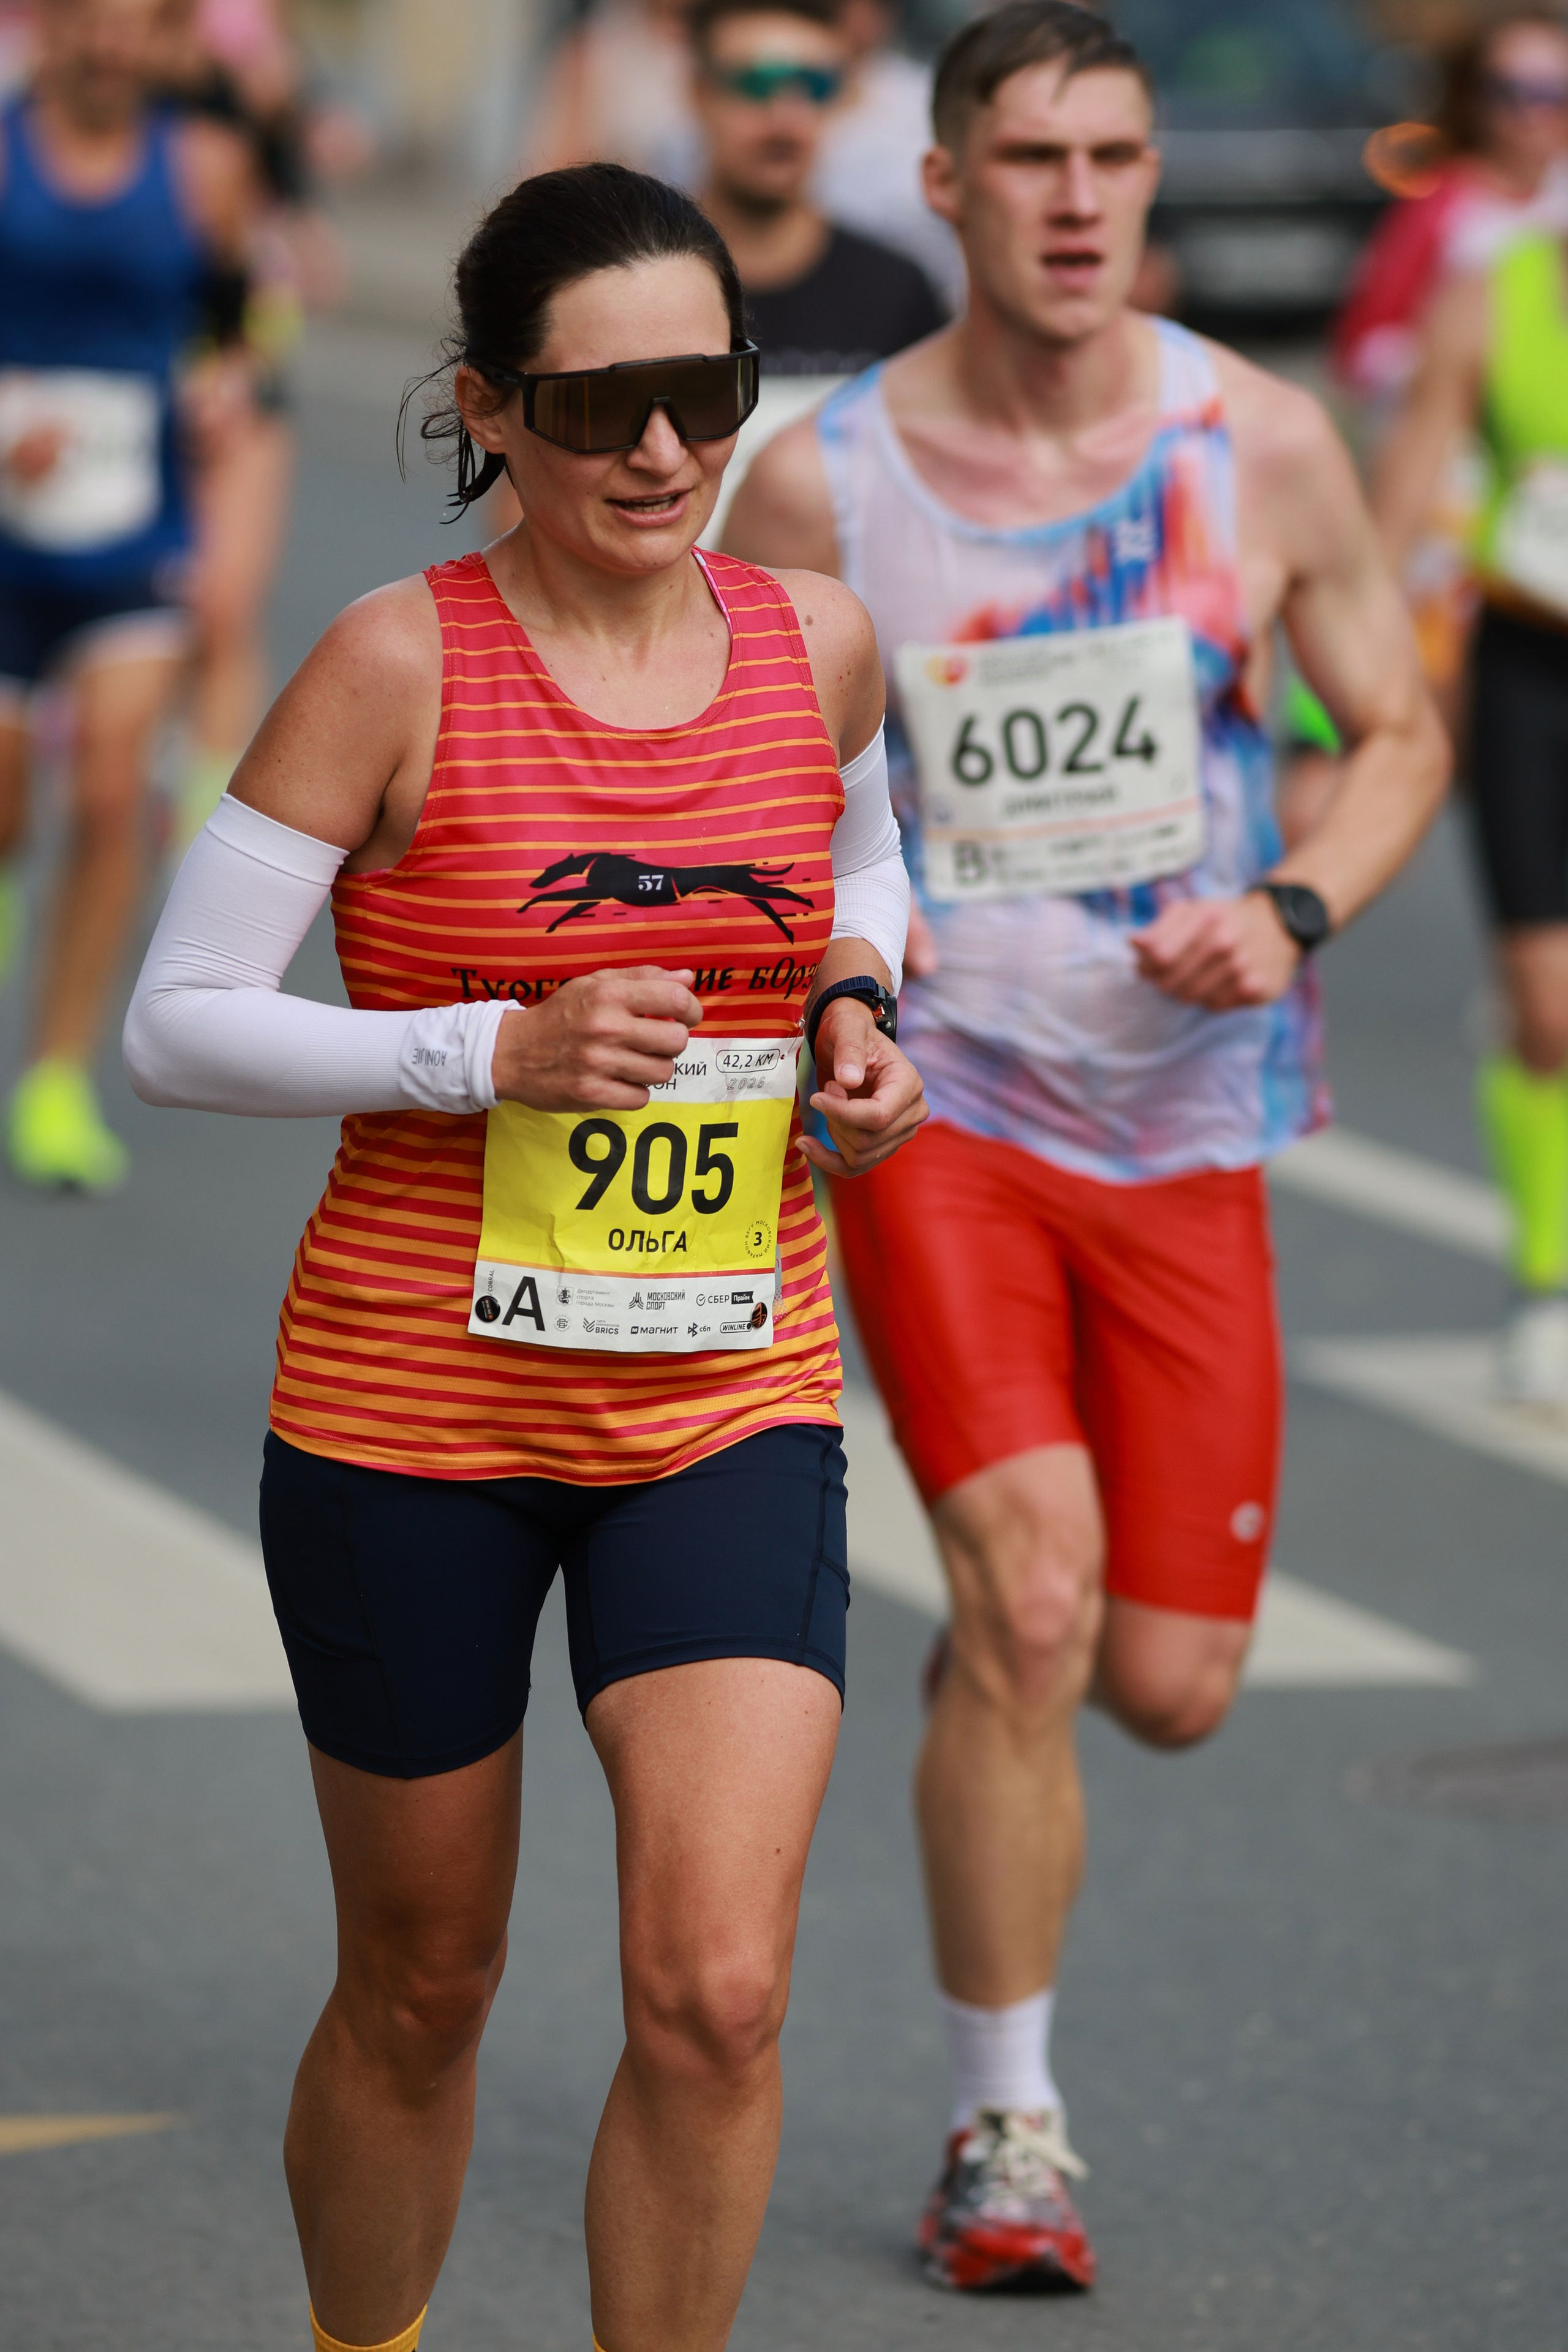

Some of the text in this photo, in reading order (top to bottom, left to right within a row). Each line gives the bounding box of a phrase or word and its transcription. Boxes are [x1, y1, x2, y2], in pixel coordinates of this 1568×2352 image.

[951, 694, 1156, 786] 6024
[638, 875, 664, 891] 57
[723, 1054, 753, 1069] 42,2
[727, 1076, 766, 1090] 2026
[568, 1117, 739, 1215] 905
[608, 1228, 687, 1253] ОЛЬГА
[753, 1231, 763, 1246] 3
[647, 1289, 685, 1301] МОСКОВСКИЙ
[707, 1295, 730, 1303] СБЕР
[646, 1302, 666, 1310] СПОРТ
[722, 1323, 747, 1332] WINLINE
